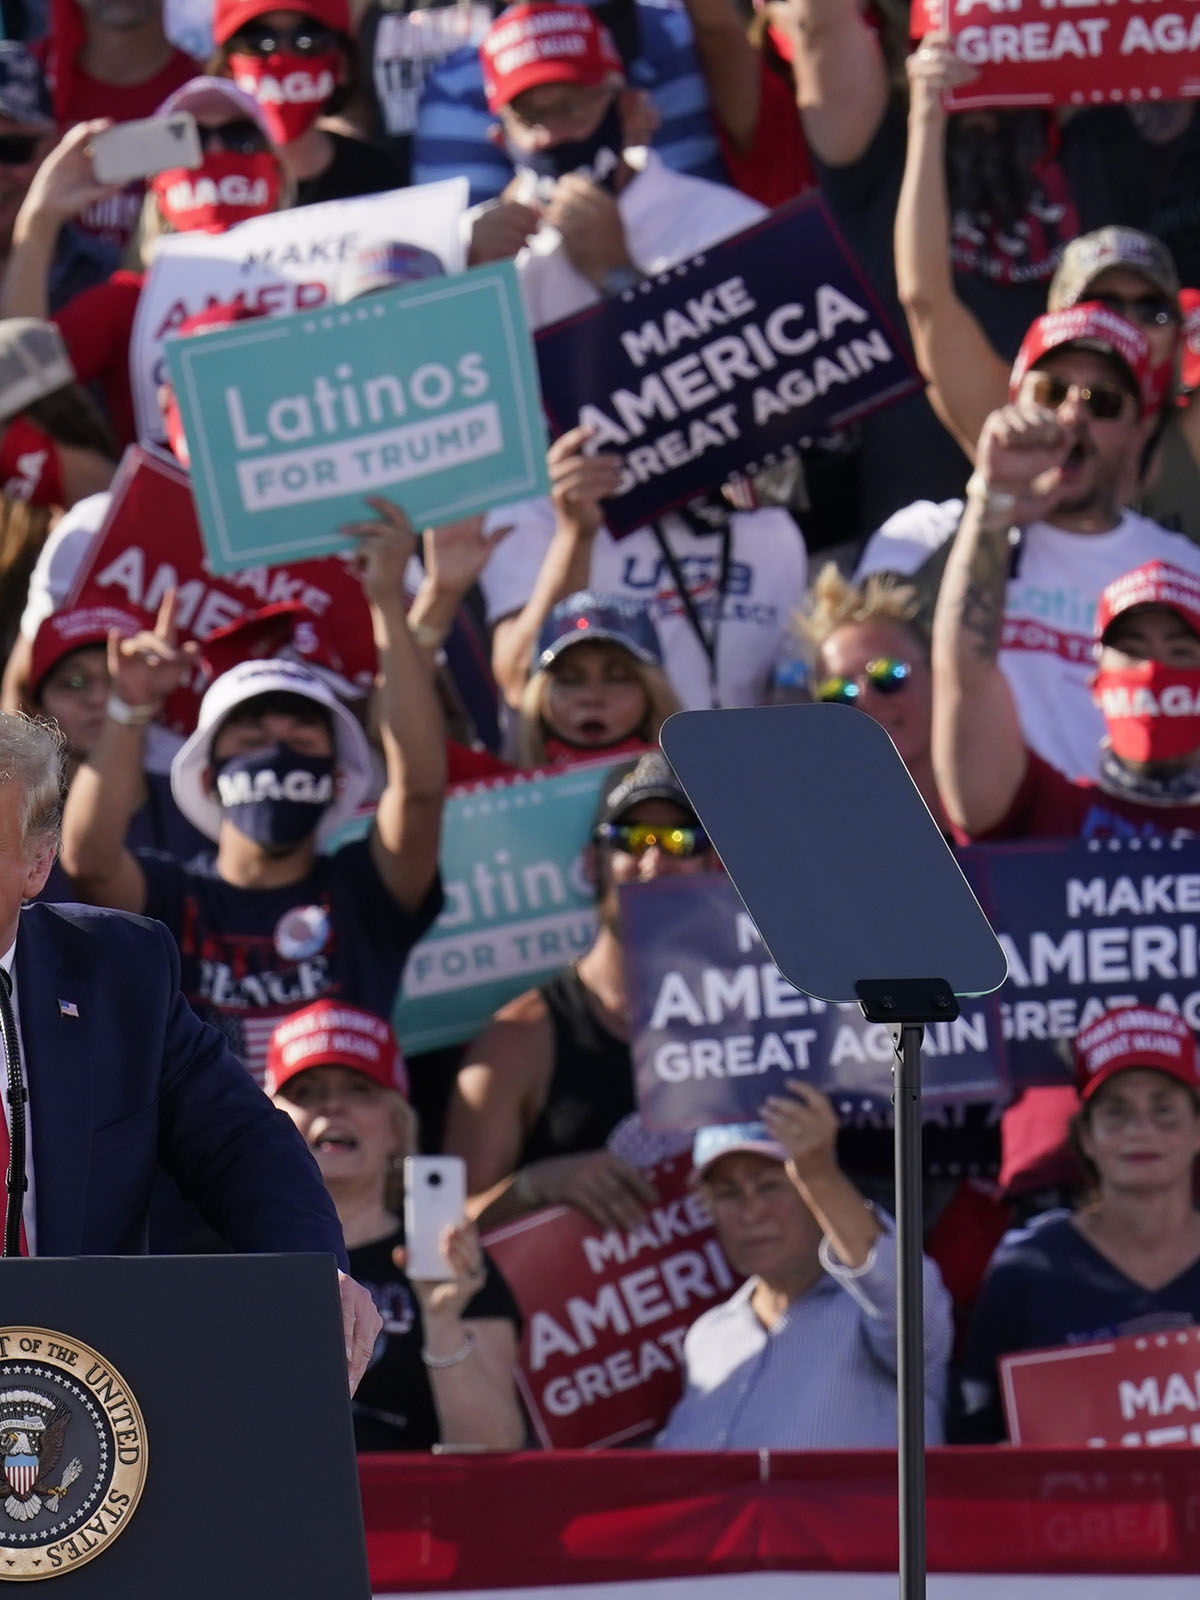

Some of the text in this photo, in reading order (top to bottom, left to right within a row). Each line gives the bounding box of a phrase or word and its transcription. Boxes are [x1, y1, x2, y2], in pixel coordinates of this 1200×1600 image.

[955, 17, 1110, 63] GREAT
[621, 275, 756, 367] MAKE
[225, 351, 490, 451] Latinos
[578, 282, 869, 455] AMERICA
[752, 330, 894, 426] AGAIN
[253, 416, 491, 497] FOR TRUMP
[96, 546, 247, 641] AME
[438, 850, 597, 929] atino
[1066, 878, 1200, 918] MAKE
[414, 922, 594, 984] FOR TRU
[997, 927, 1200, 988] AMERI
[649, 967, 806, 1030] AME
[655, 1030, 817, 1083] GREAT
[583, 1196, 713, 1275] MAKE
[19, 1337, 43, 1353] OF
[48, 1342, 80, 1368] THE
[542, 1327, 686, 1419] GREAT
[85, 1361, 140, 1466] UNITED
[1119, 1370, 1200, 1421] MA
[46, 1488, 130, 1568] STATES
